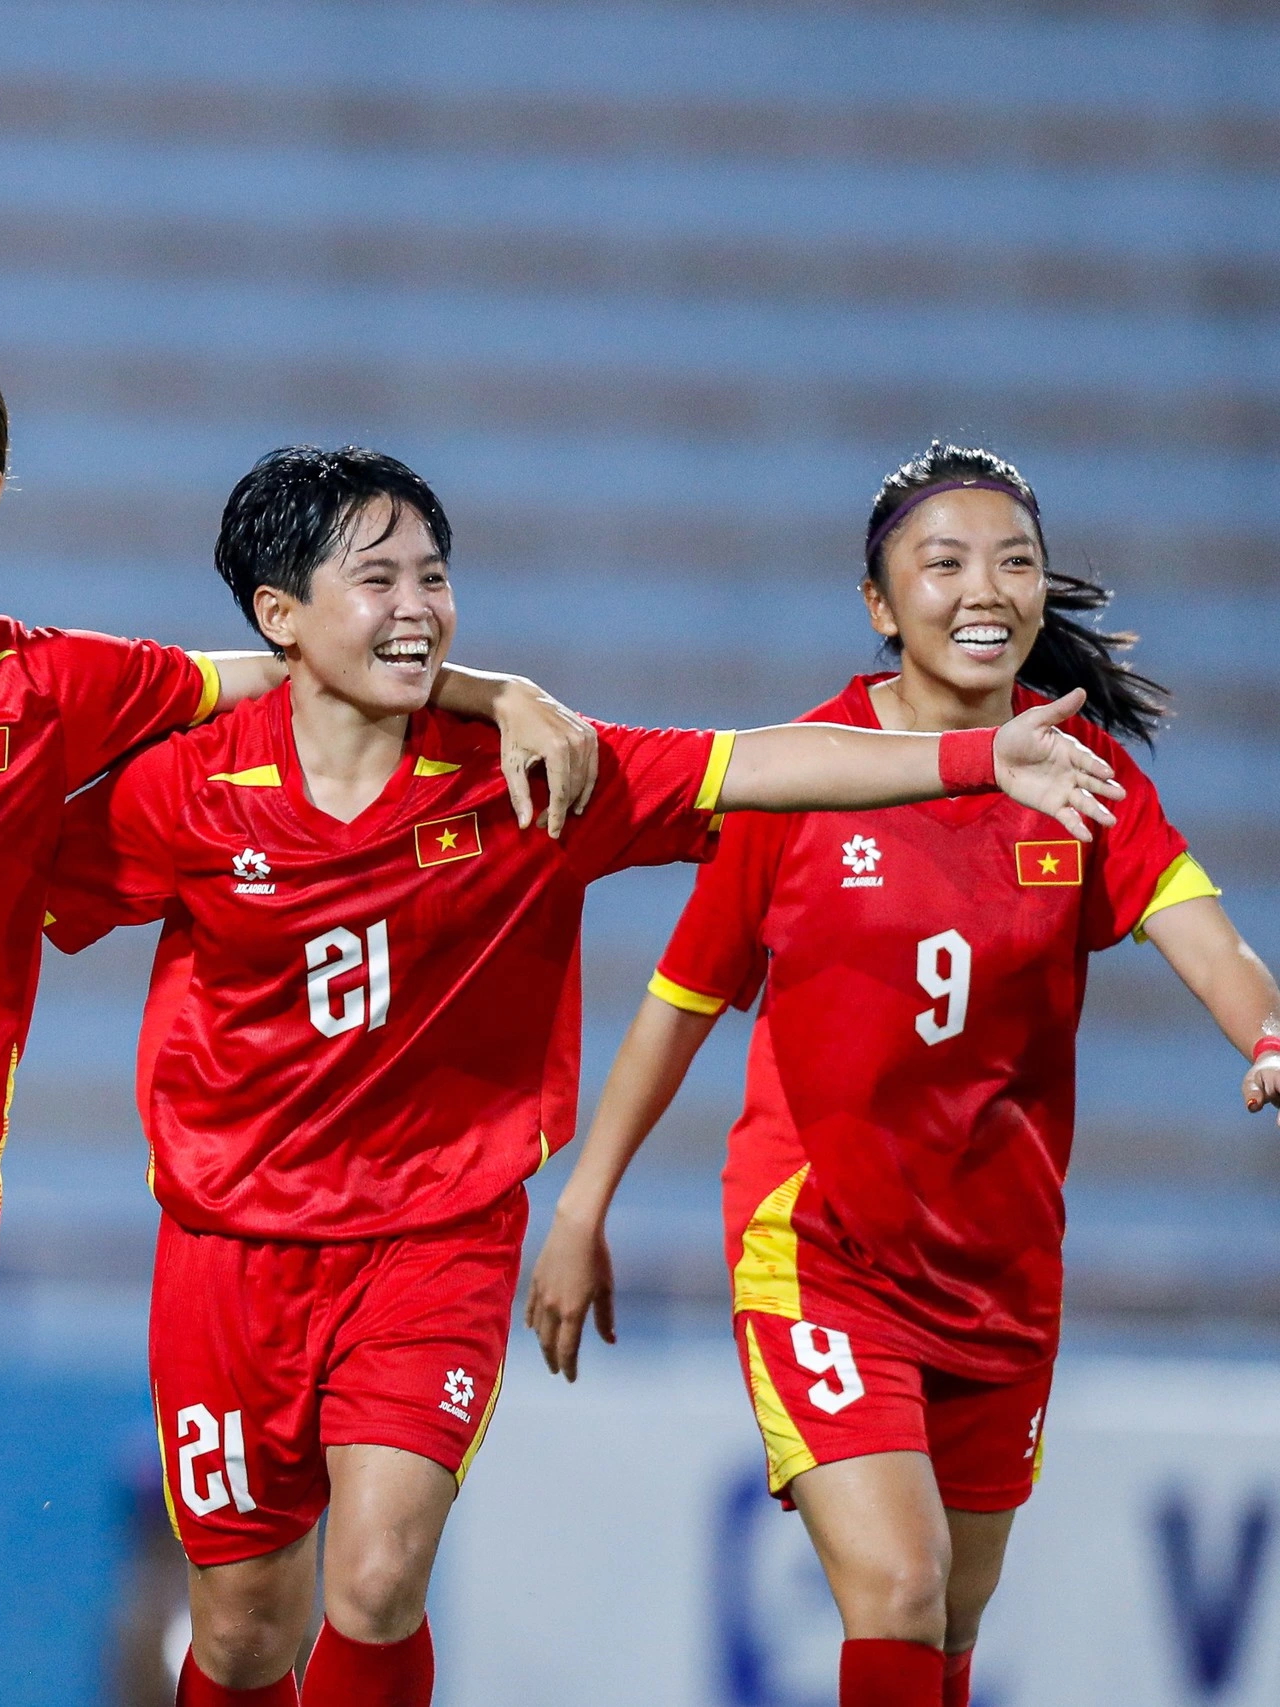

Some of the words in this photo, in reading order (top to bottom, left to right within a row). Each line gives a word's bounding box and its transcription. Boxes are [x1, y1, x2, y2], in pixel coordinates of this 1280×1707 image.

[233, 883, 276, 895] JOGARBOLA
[304, 918, 391, 1039] 21
[915, 928, 972, 1047] 9
[789, 1319, 866, 1416] 9
[177, 1402, 257, 1517] 21
